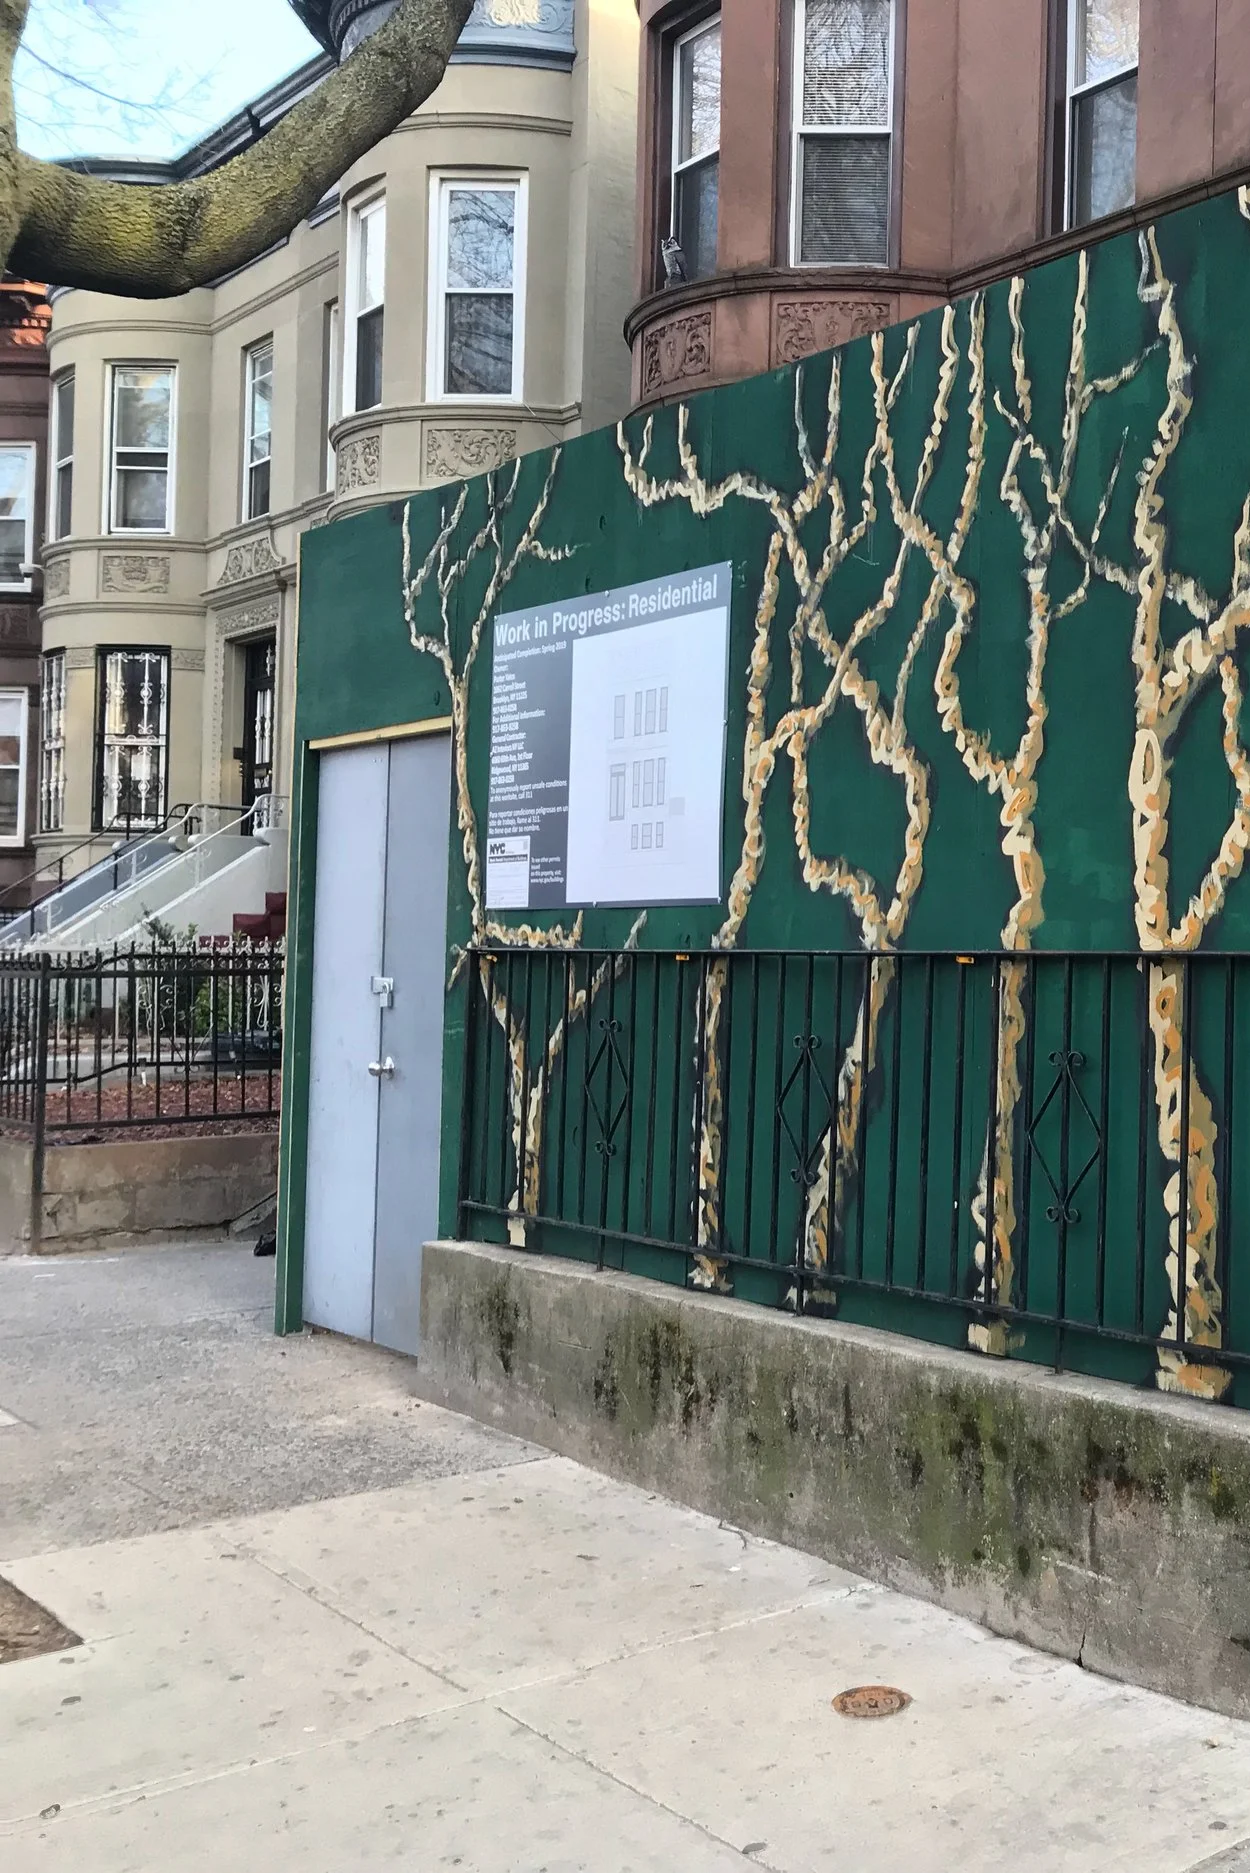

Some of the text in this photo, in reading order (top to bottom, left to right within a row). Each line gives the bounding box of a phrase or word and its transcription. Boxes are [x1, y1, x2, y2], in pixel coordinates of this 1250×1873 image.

[496, 574, 718, 647] Work in Progress: Residential
[542, 644, 555, 654] Spring
[490, 843, 505, 855] NYC
